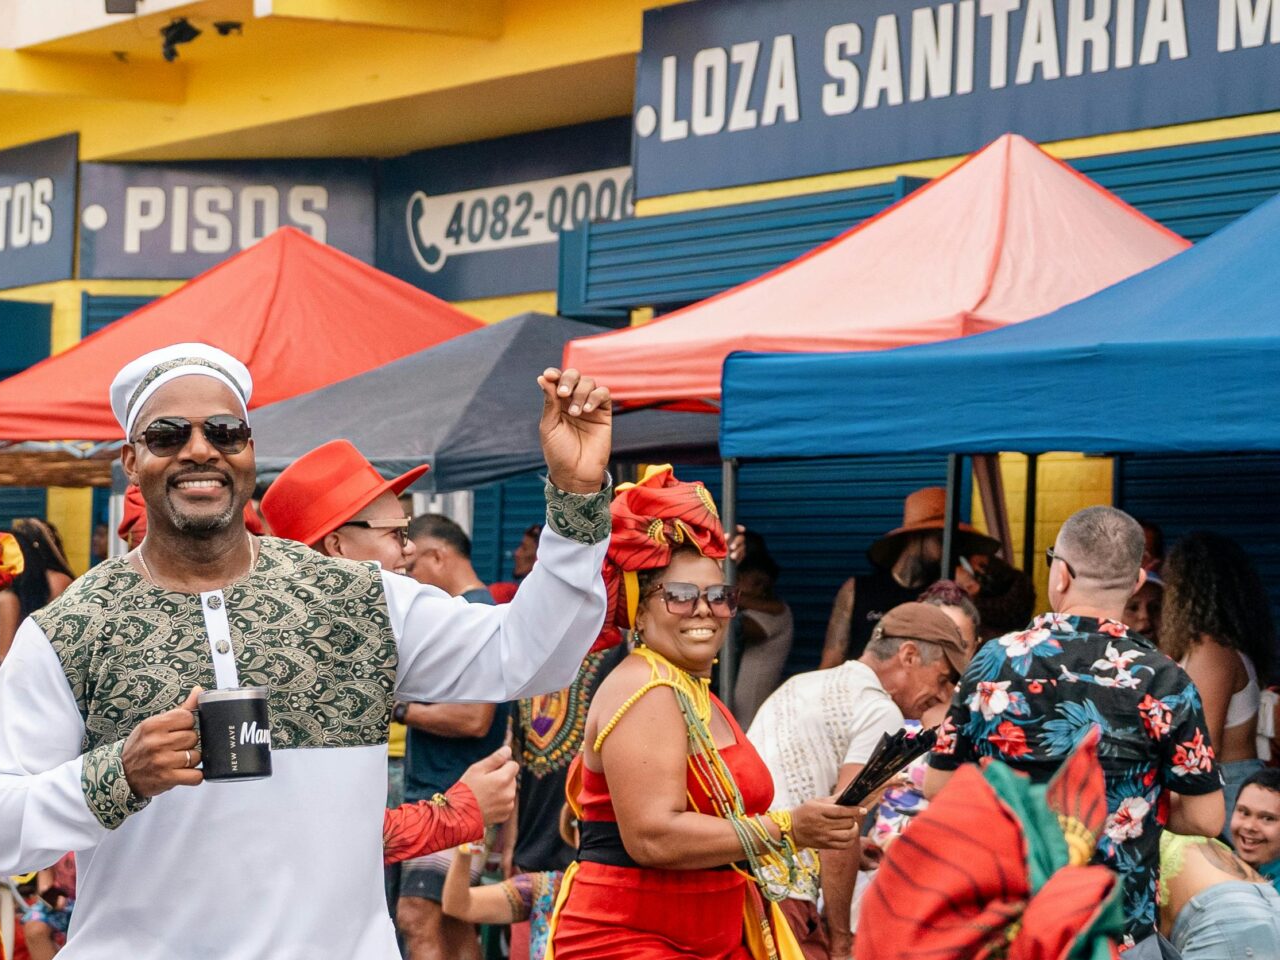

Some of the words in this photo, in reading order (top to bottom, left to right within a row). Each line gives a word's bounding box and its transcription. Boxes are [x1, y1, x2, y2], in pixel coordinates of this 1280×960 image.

[660, 33, 800, 142] LOZA
[822, 0, 1189, 116] SANITARIA
[123, 184, 329, 254] PISOS
[228, 725, 236, 749] WAVE
[230, 752, 239, 772] NEW
